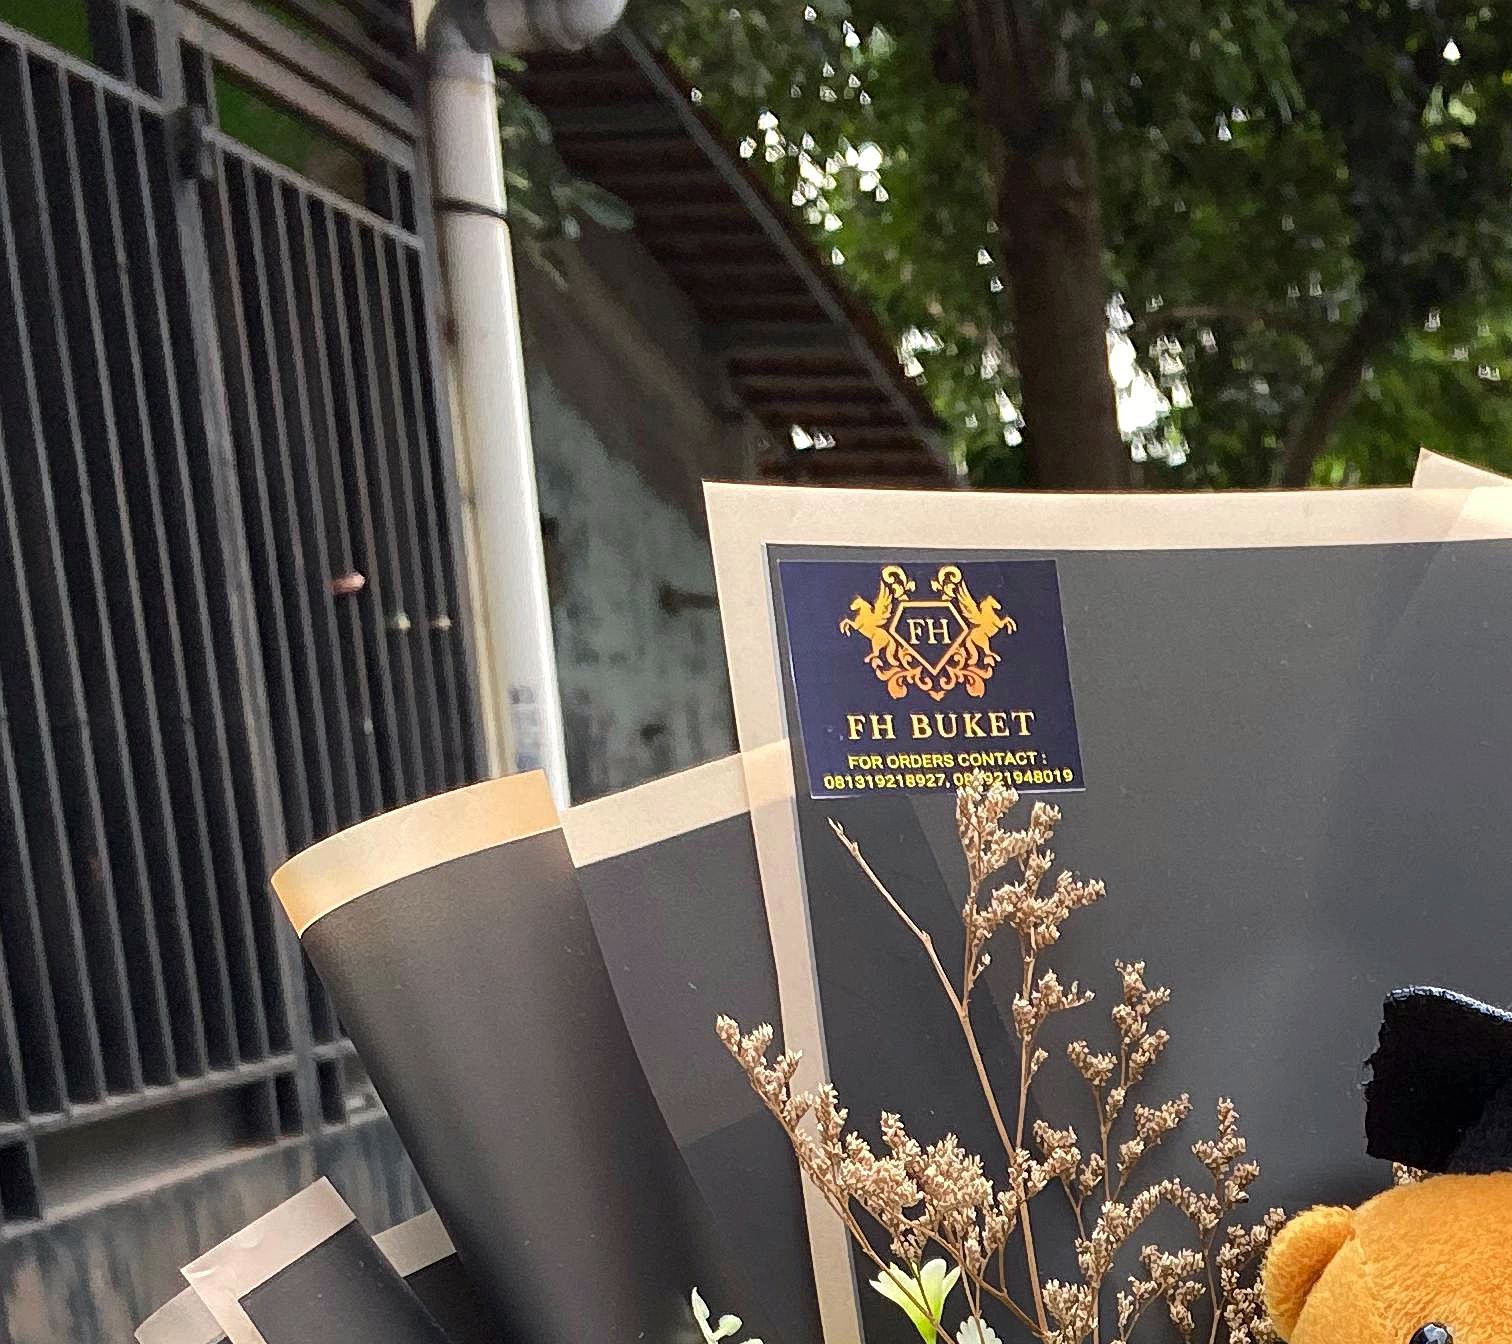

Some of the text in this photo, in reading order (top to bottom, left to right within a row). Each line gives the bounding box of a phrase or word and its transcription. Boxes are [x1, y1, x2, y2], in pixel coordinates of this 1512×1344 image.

[907, 618, 950, 644] FH
[847, 711, 1034, 740] FH BUKET
[848, 755, 883, 770] FOR
[887, 754, 954, 769] ORDERS
[958, 752, 1037, 767] CONTACT
